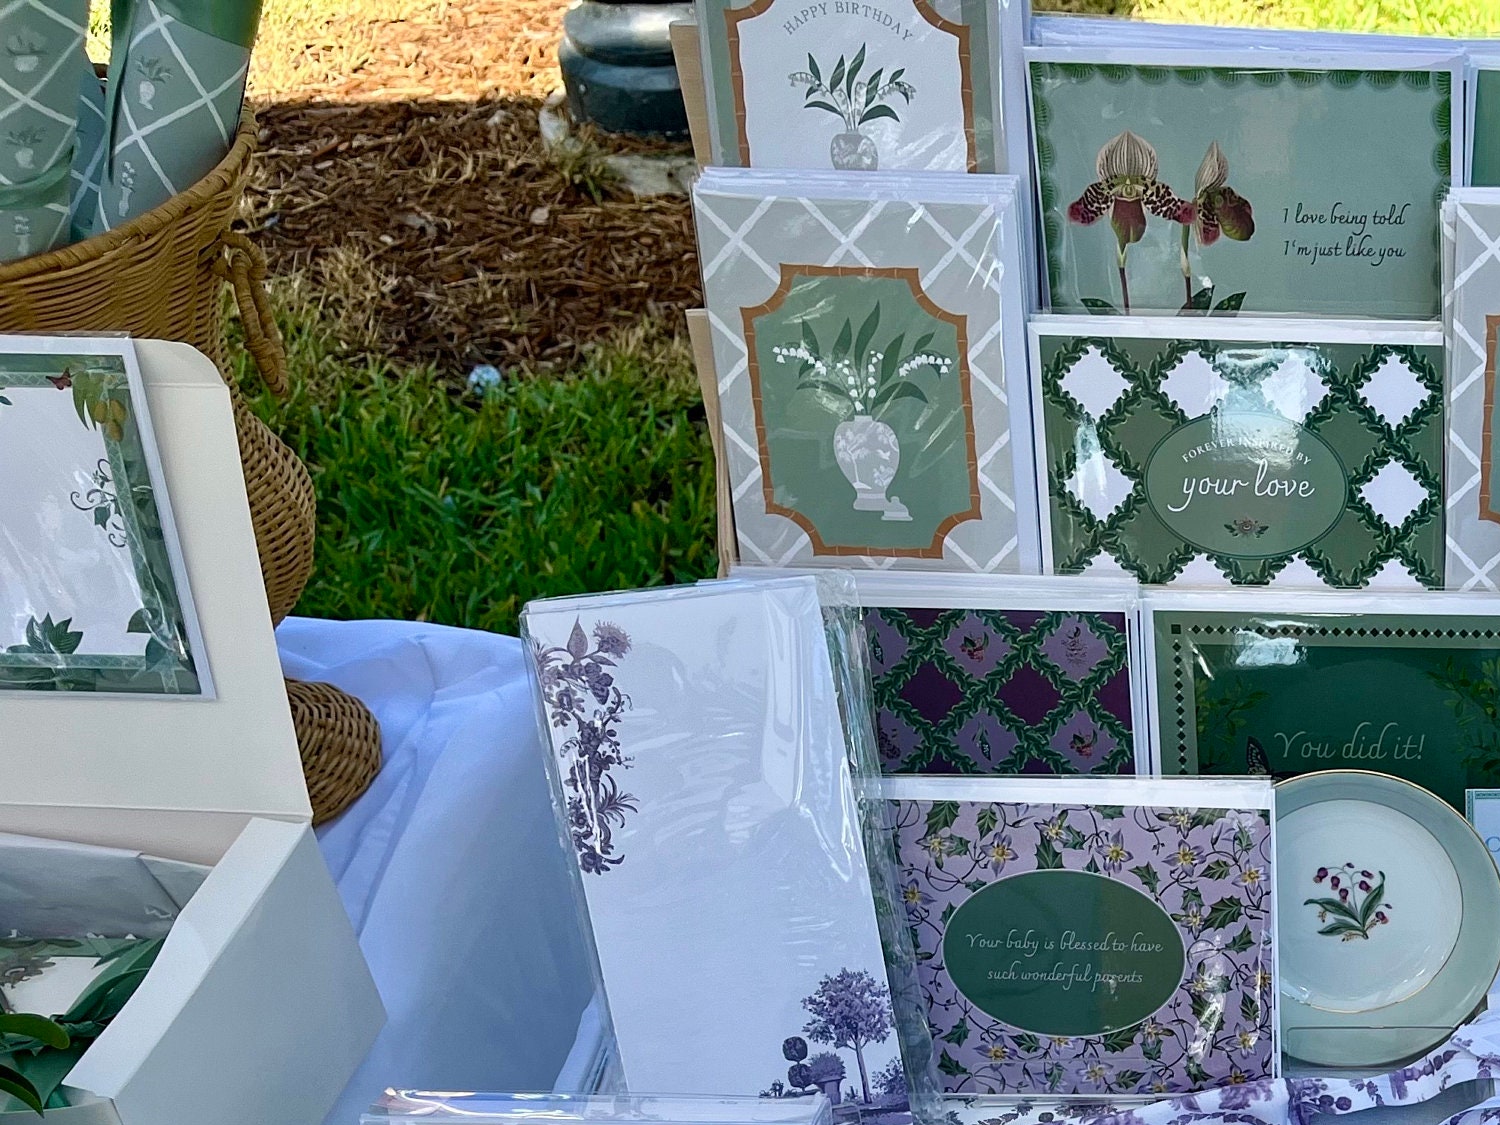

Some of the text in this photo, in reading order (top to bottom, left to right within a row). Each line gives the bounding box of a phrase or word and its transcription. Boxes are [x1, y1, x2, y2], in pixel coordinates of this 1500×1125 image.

[783, 1, 913, 41] HAPPY BIRTHDAY
[1283, 202, 1411, 236] I love being told
[1311, 242, 1342, 265] just
[1345, 234, 1376, 257] like
[1371, 246, 1406, 266] you
[1181, 438, 1235, 463] FOREVER
[1296, 452, 1312, 466] BY
[1167, 458, 1315, 512] your love
[1274, 721, 1426, 760] You did it!
[965, 929, 1164, 957] Your baby is blessed to have
[987, 960, 1143, 992] such wonderful parents
